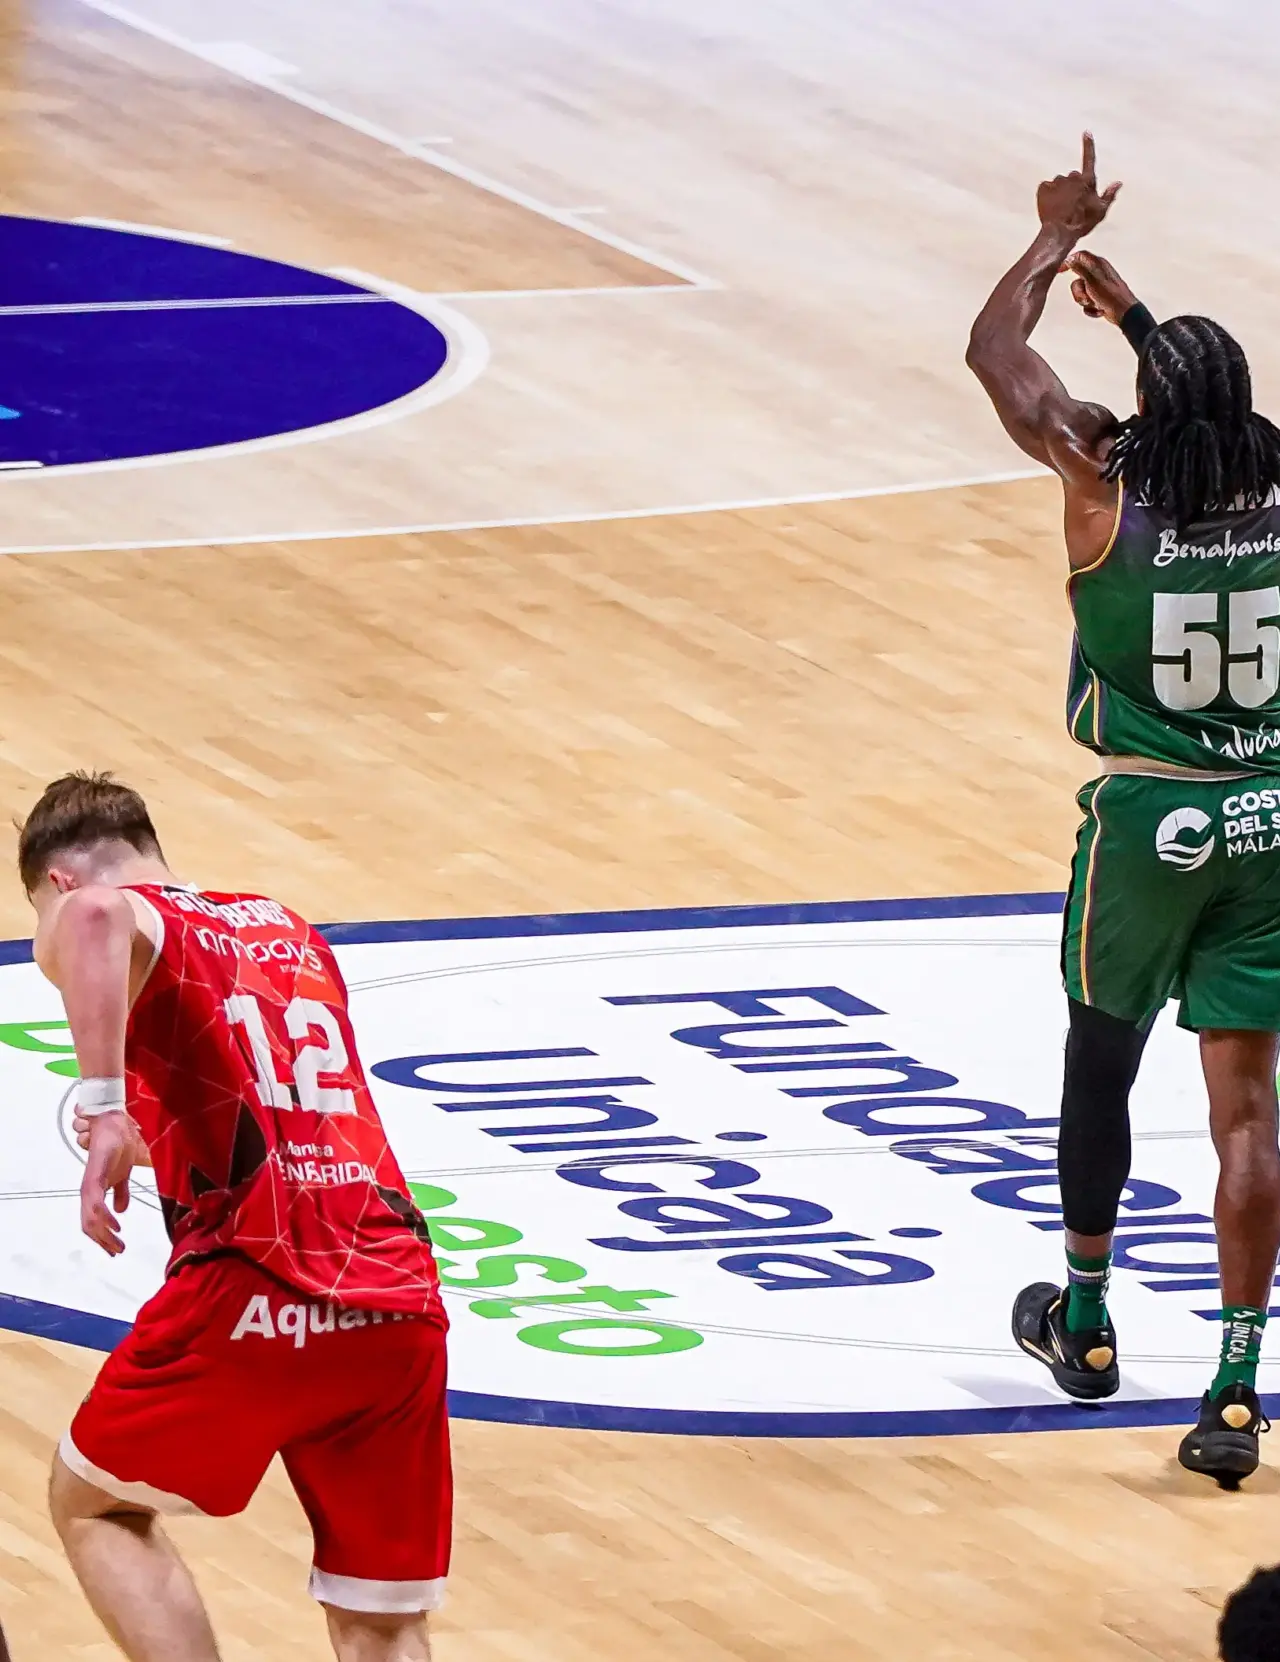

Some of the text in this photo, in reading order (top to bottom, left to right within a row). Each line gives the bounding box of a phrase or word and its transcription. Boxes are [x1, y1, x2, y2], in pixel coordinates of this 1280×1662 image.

[1224, 814, 1268, 839] DEL
[223, 994, 358, 1116] 12
[370, 1046, 943, 1291] Unicaja
